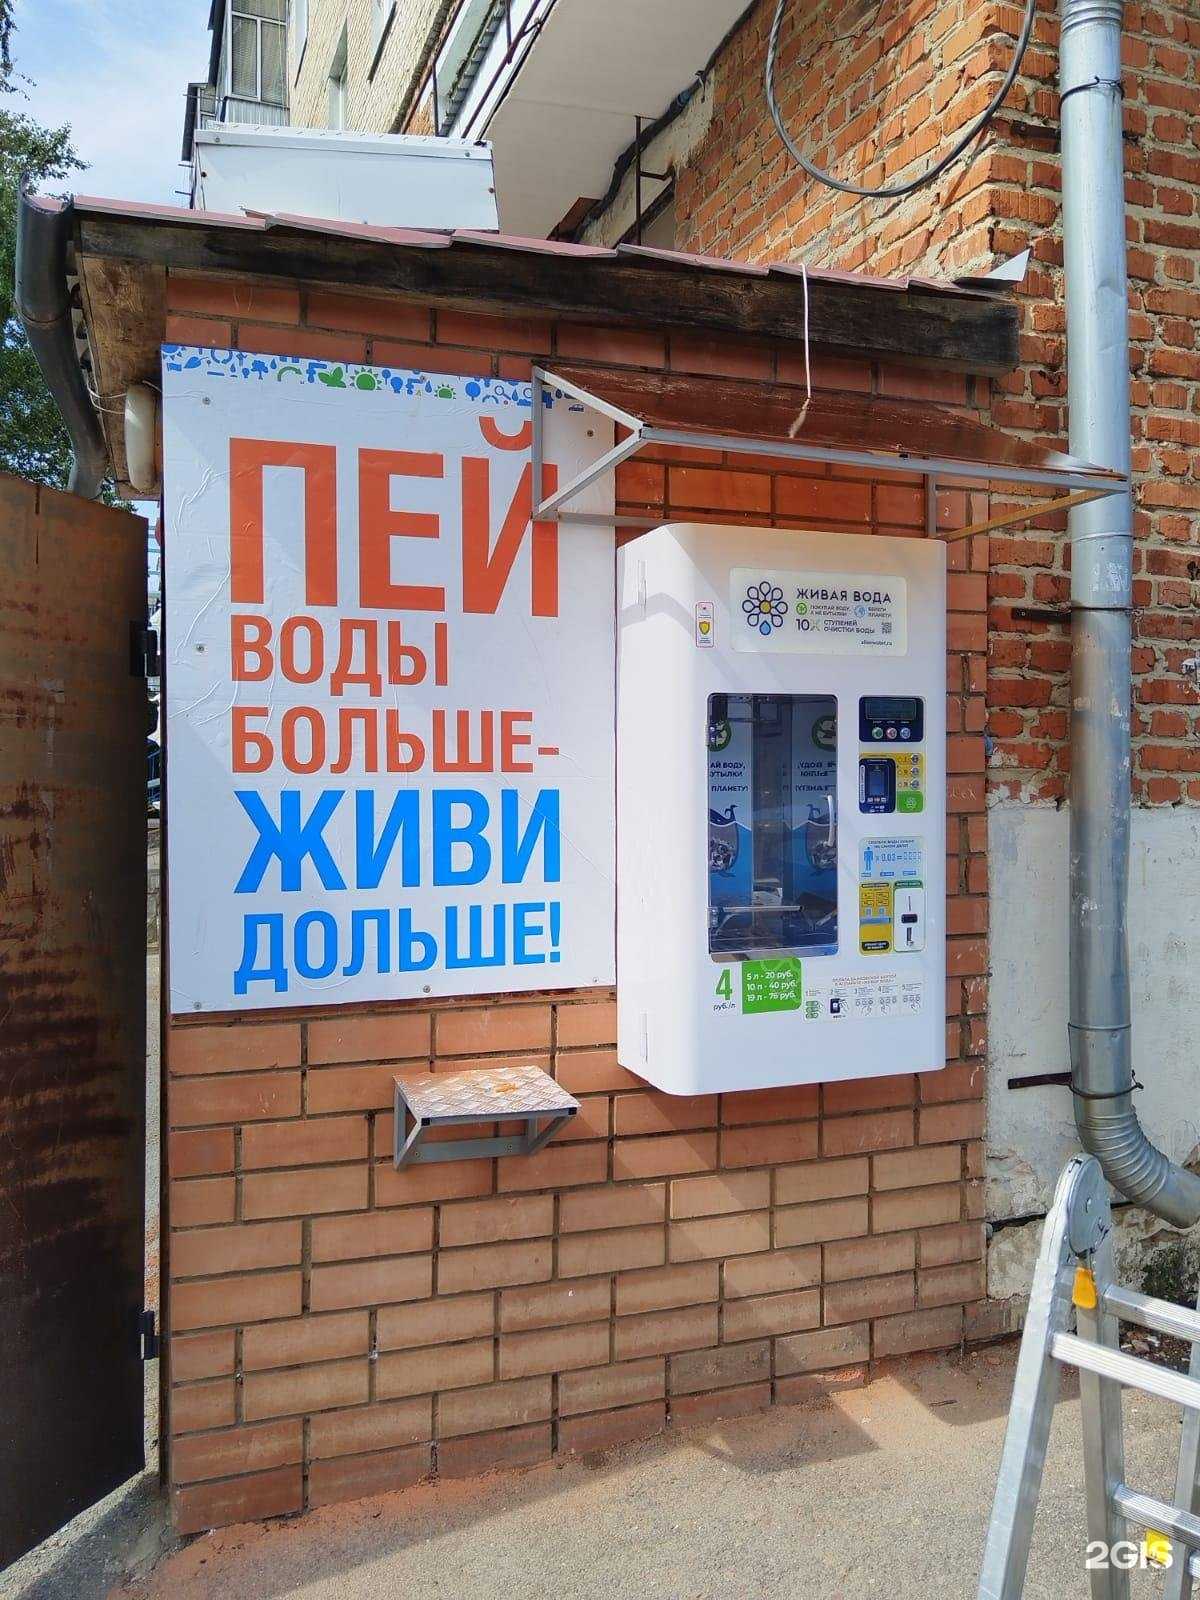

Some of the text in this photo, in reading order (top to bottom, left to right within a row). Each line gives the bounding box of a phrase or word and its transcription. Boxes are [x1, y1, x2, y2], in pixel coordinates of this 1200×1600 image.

[229, 417, 559, 617] ПЕЙ
[796, 588, 892, 604] ЖИВАЯ ВОДА
[795, 618, 810, 631] 10
[856, 627, 875, 635] ВОДЫ
[230, 614, 449, 697] ВОДЫ
[231, 706, 560, 774] БОЛЬШЕ-
[722, 761, 746, 769] ВОДУ,
[711, 785, 749, 793] ПЛАНЕТУ!
[233, 788, 561, 893] ЖИВИ
[233, 901, 561, 995] ДОЛЬШЕ!
[746, 973, 752, 981] 5
[765, 971, 775, 979] 20
[777, 969, 793, 980] руб.
[715, 968, 733, 1001] 4
[746, 983, 756, 991] 10
[769, 981, 780, 989] 40
[781, 979, 798, 990] руб.
[780, 990, 796, 1001] руб.
